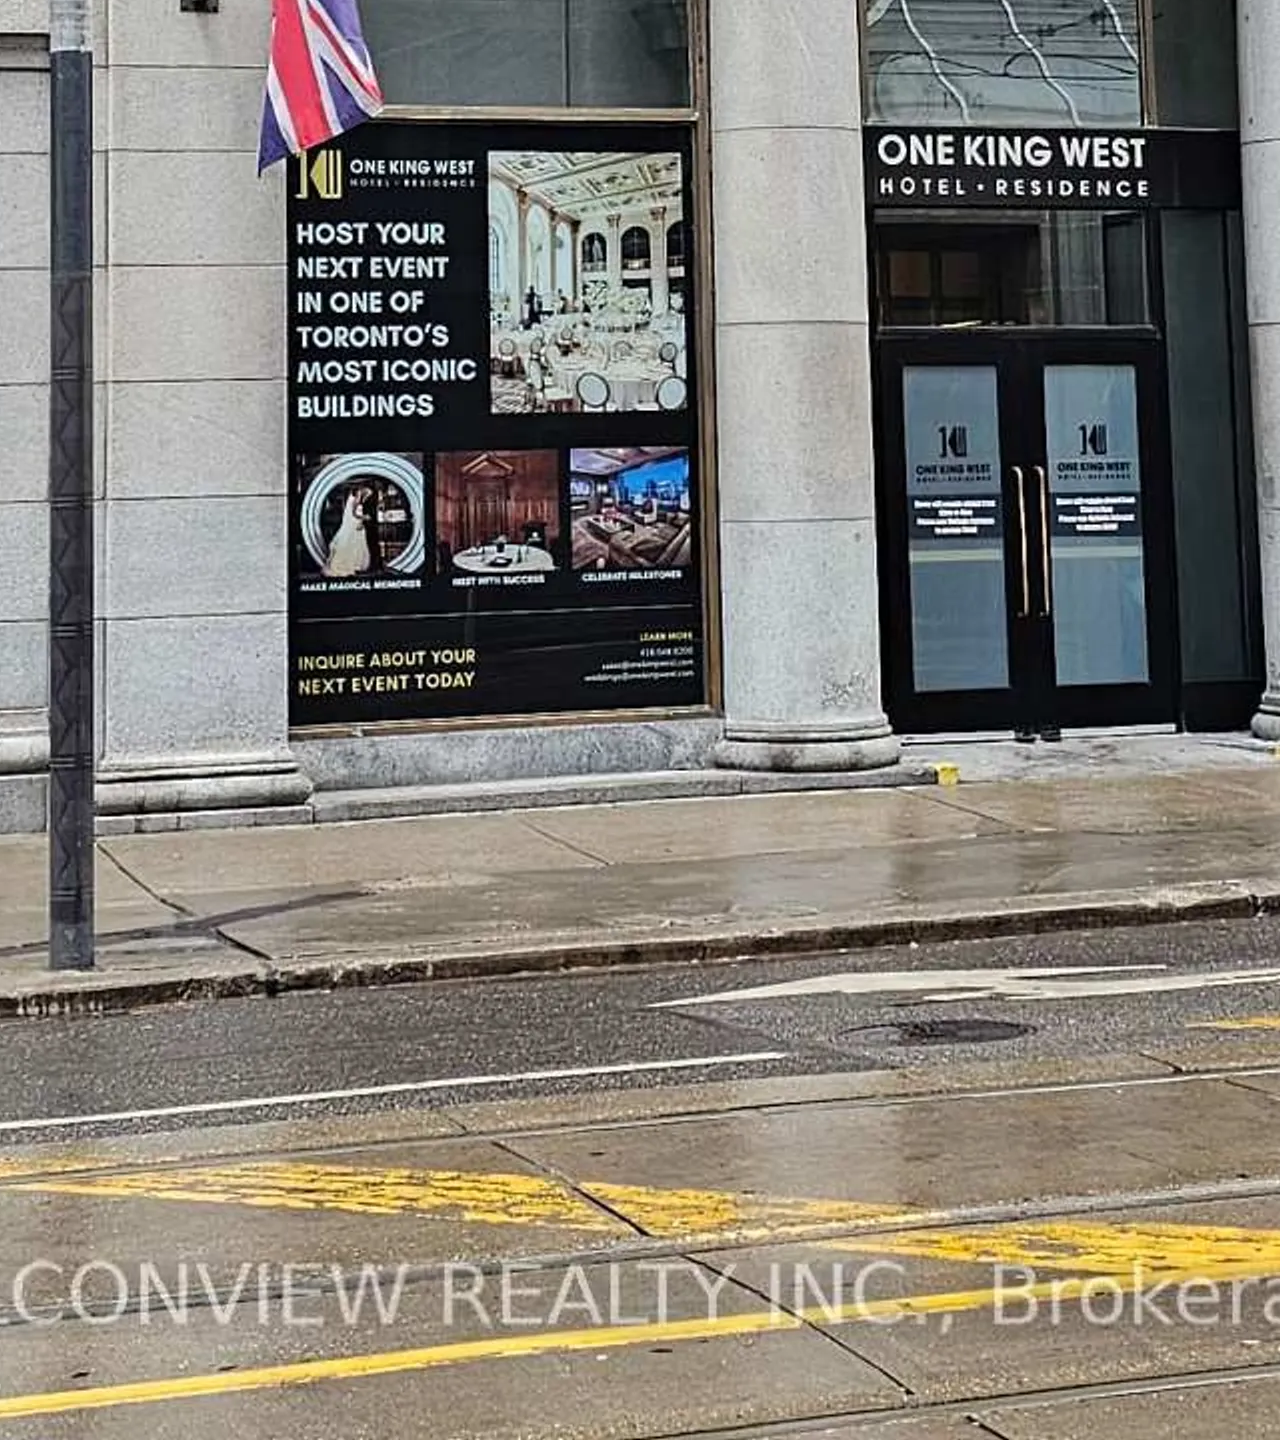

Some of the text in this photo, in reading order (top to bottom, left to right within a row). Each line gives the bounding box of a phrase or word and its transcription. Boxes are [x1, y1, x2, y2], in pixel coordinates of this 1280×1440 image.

[878, 134, 1146, 168] ONE KING WEST
[350, 158, 475, 175] ONE KING WEST
[880, 177, 1149, 197] HOTEL RESIDENCE
[296, 222, 445, 245] HOST YOUR
[297, 256, 449, 279] NEXT EVENT
[297, 290, 424, 313] IN ONE OF
[297, 358, 477, 383] MOST ICONIC
[297, 394, 434, 418] BUILDINGS
[916, 463, 991, 475] ONE KING WEST
[1057, 461, 1132, 473] ONE KING WEST
[298, 647, 476, 671] INQUIRE ABOUT YOUR
[298, 671, 476, 696] NEXT EVENT TODAY
